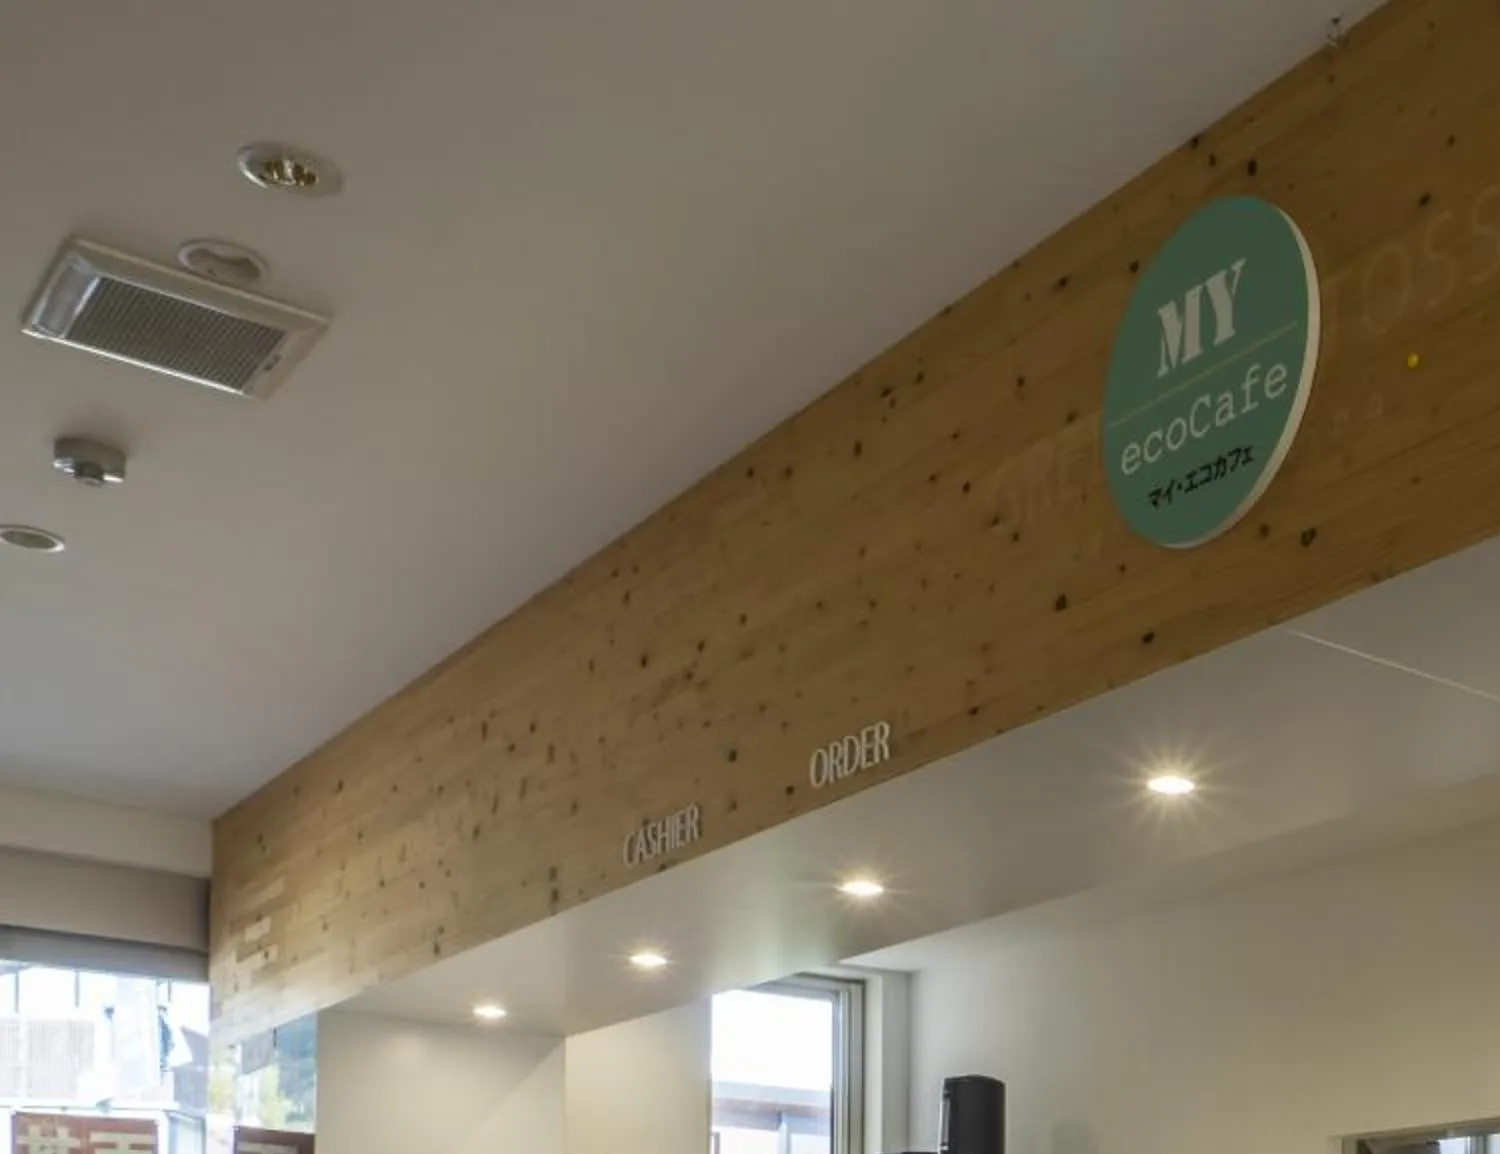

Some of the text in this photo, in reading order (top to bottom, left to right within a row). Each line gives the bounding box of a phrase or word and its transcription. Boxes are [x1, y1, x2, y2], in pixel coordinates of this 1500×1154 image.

[1155, 257, 1248, 379] MY
[1120, 361, 1289, 476] ecoCafe
[1147, 446, 1255, 509] マイ・エコカフェ
[808, 720, 892, 789] ORDER
[622, 803, 700, 868] CASHIER
